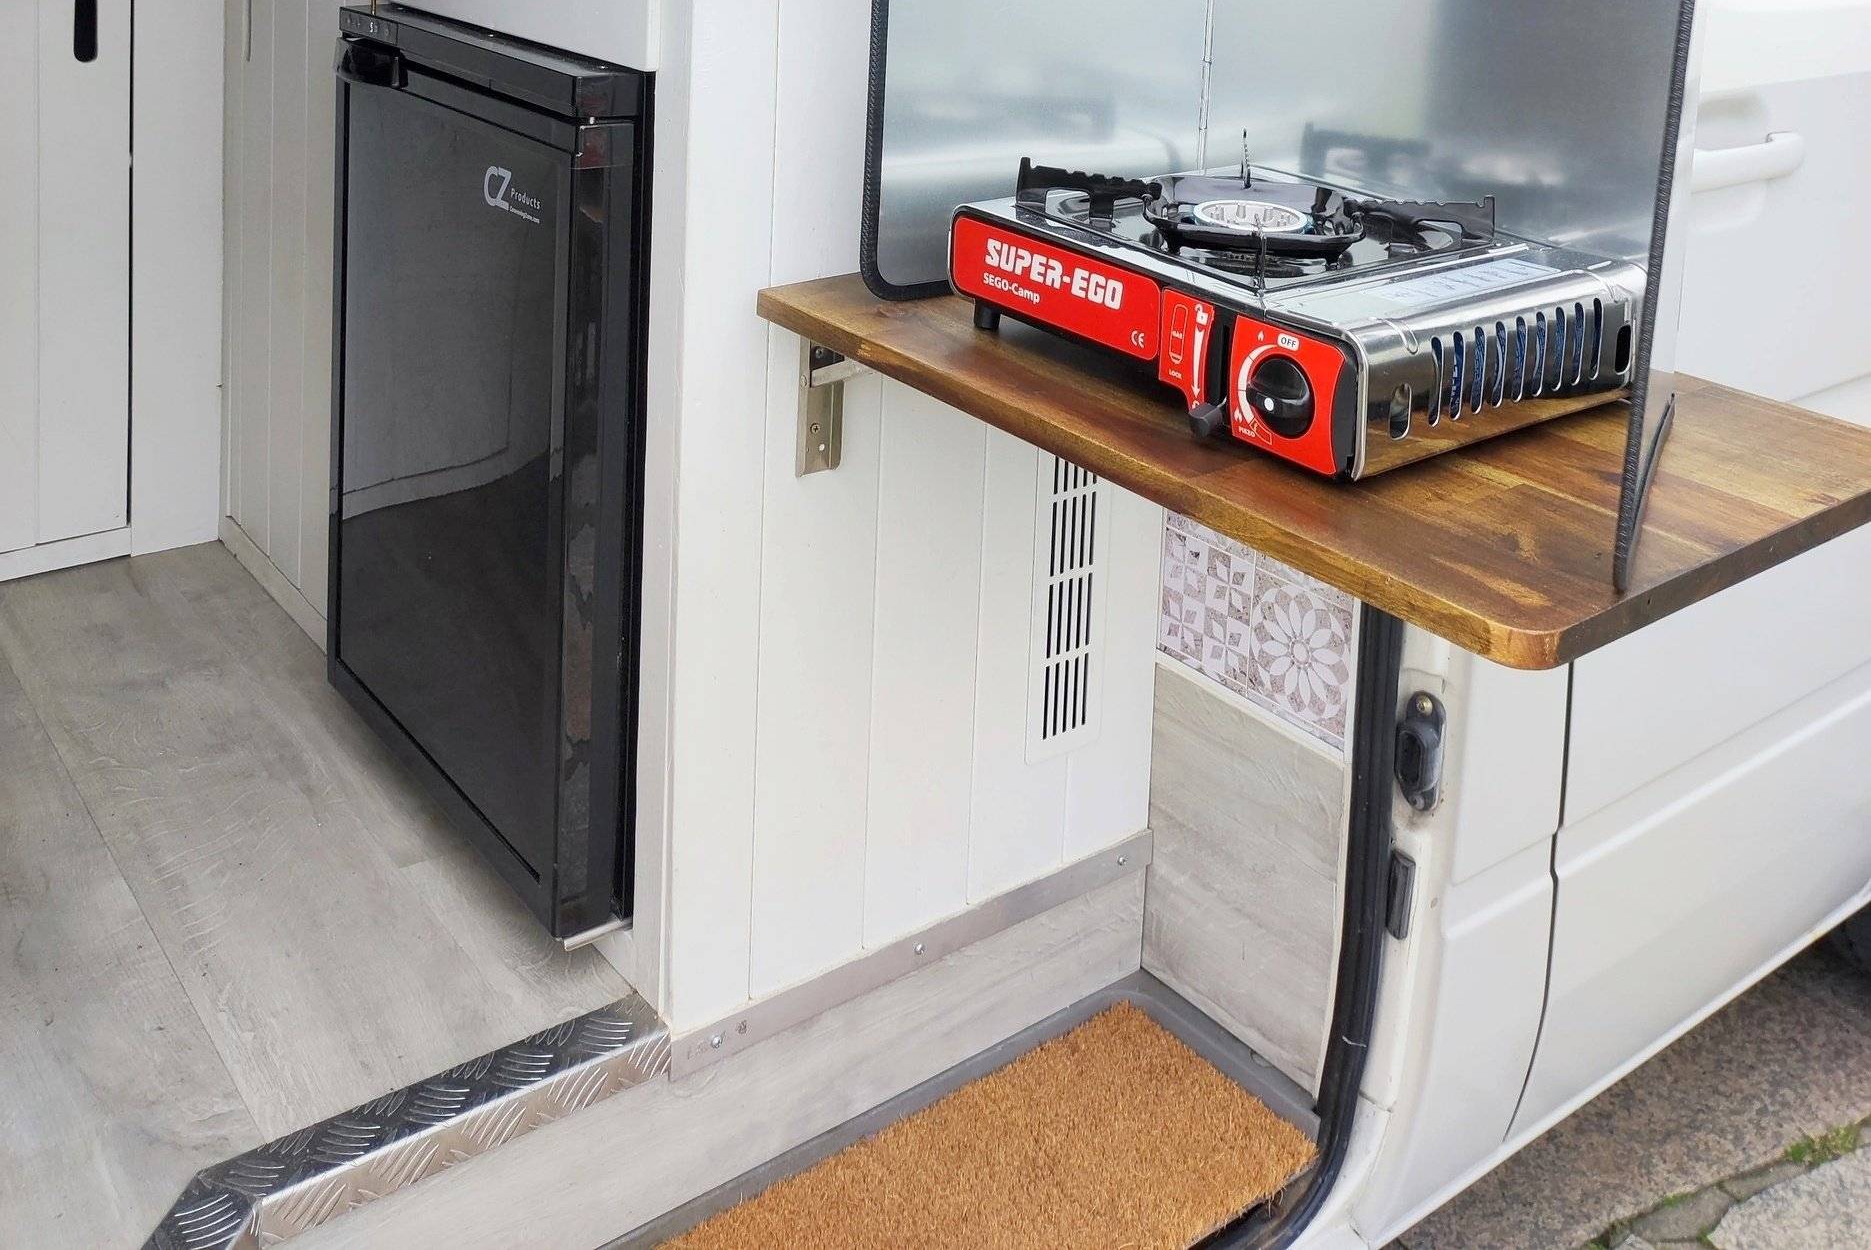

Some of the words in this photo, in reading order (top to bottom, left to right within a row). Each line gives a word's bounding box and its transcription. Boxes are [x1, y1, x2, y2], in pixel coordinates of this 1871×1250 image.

[511, 188, 540, 209] Products
[985, 238, 1123, 310] SUPER-EGO
[983, 272, 1040, 304] SEGO-Camp
[1281, 337, 1296, 348] OFF
